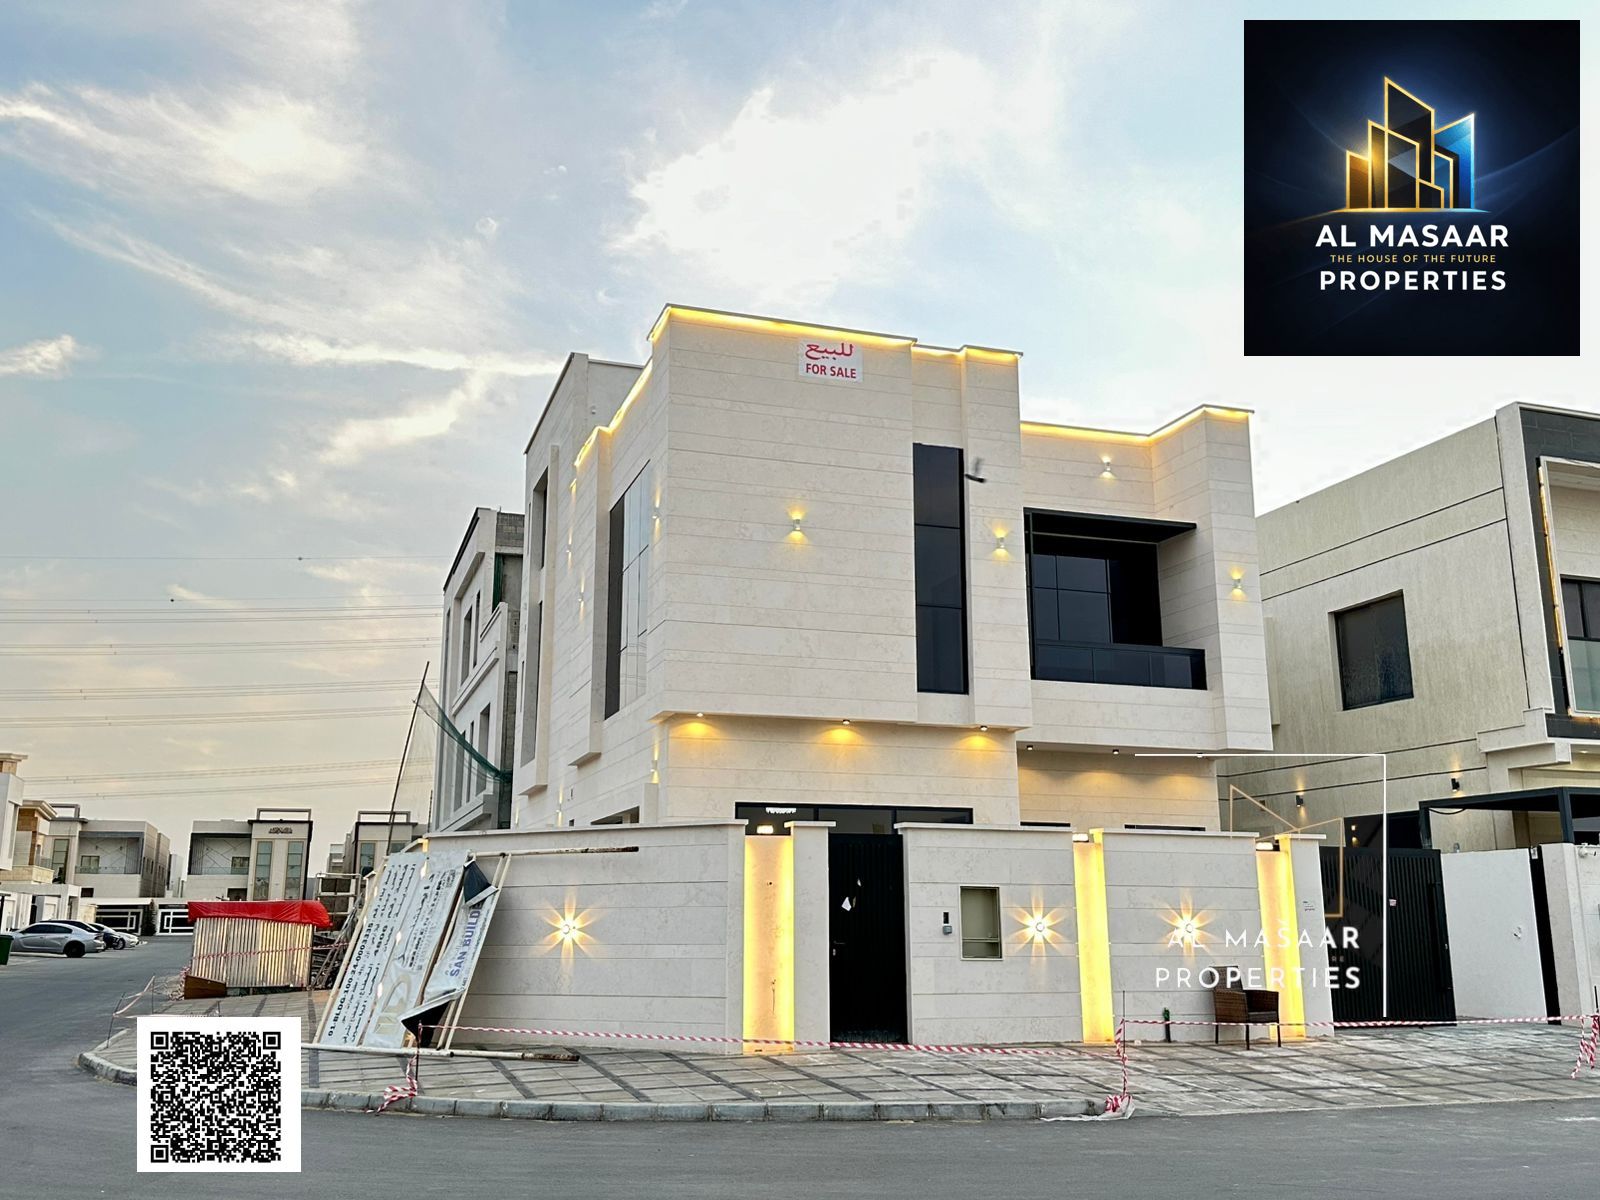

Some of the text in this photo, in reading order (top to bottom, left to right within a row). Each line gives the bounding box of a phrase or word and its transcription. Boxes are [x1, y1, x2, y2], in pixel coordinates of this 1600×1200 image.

[805, 342, 854, 360] للبيع
[806, 363, 857, 379] FOR SALE
[450, 951, 468, 977] SAN
